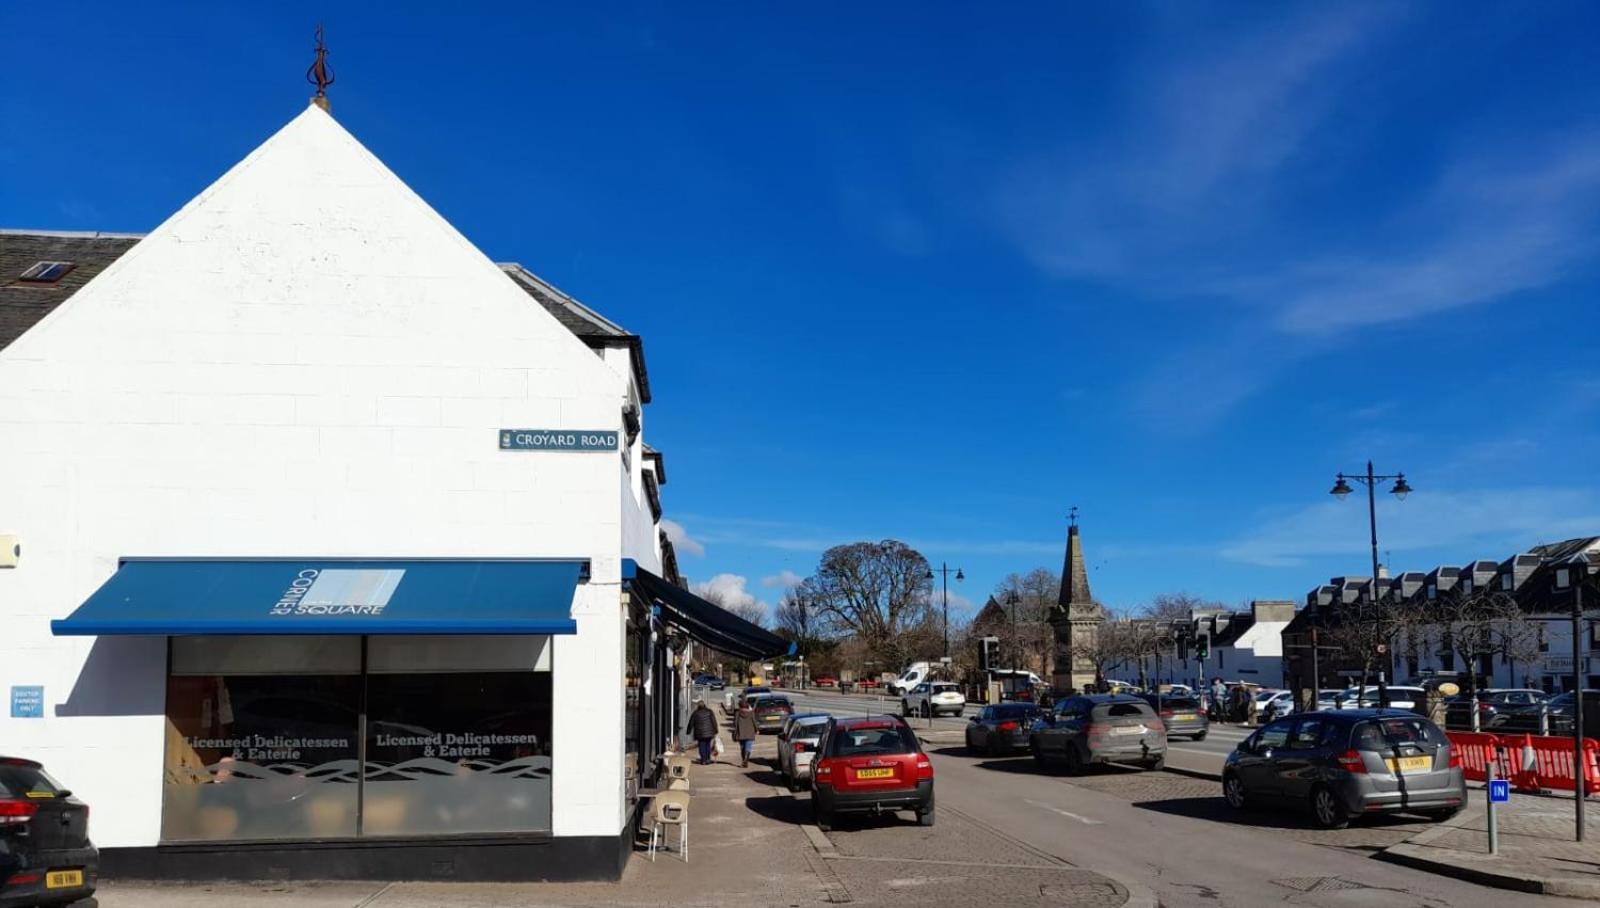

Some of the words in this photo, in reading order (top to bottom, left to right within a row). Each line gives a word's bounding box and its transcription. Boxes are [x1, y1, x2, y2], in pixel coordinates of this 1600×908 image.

[515, 434, 576, 446] CROYARD
[581, 435, 616, 446] ROAD
[270, 568, 319, 616] CORNER
[294, 604, 385, 616] SQUARE
[255, 735, 349, 748] Delicatessen
[376, 733, 442, 746] Licensed
[446, 732, 537, 745] Delicatessen
[232, 748, 245, 760] &
[248, 747, 301, 760] Eaterie
[423, 746, 436, 757] &
[439, 744, 491, 757] Eaterie
[1493, 785, 1505, 797] IN
